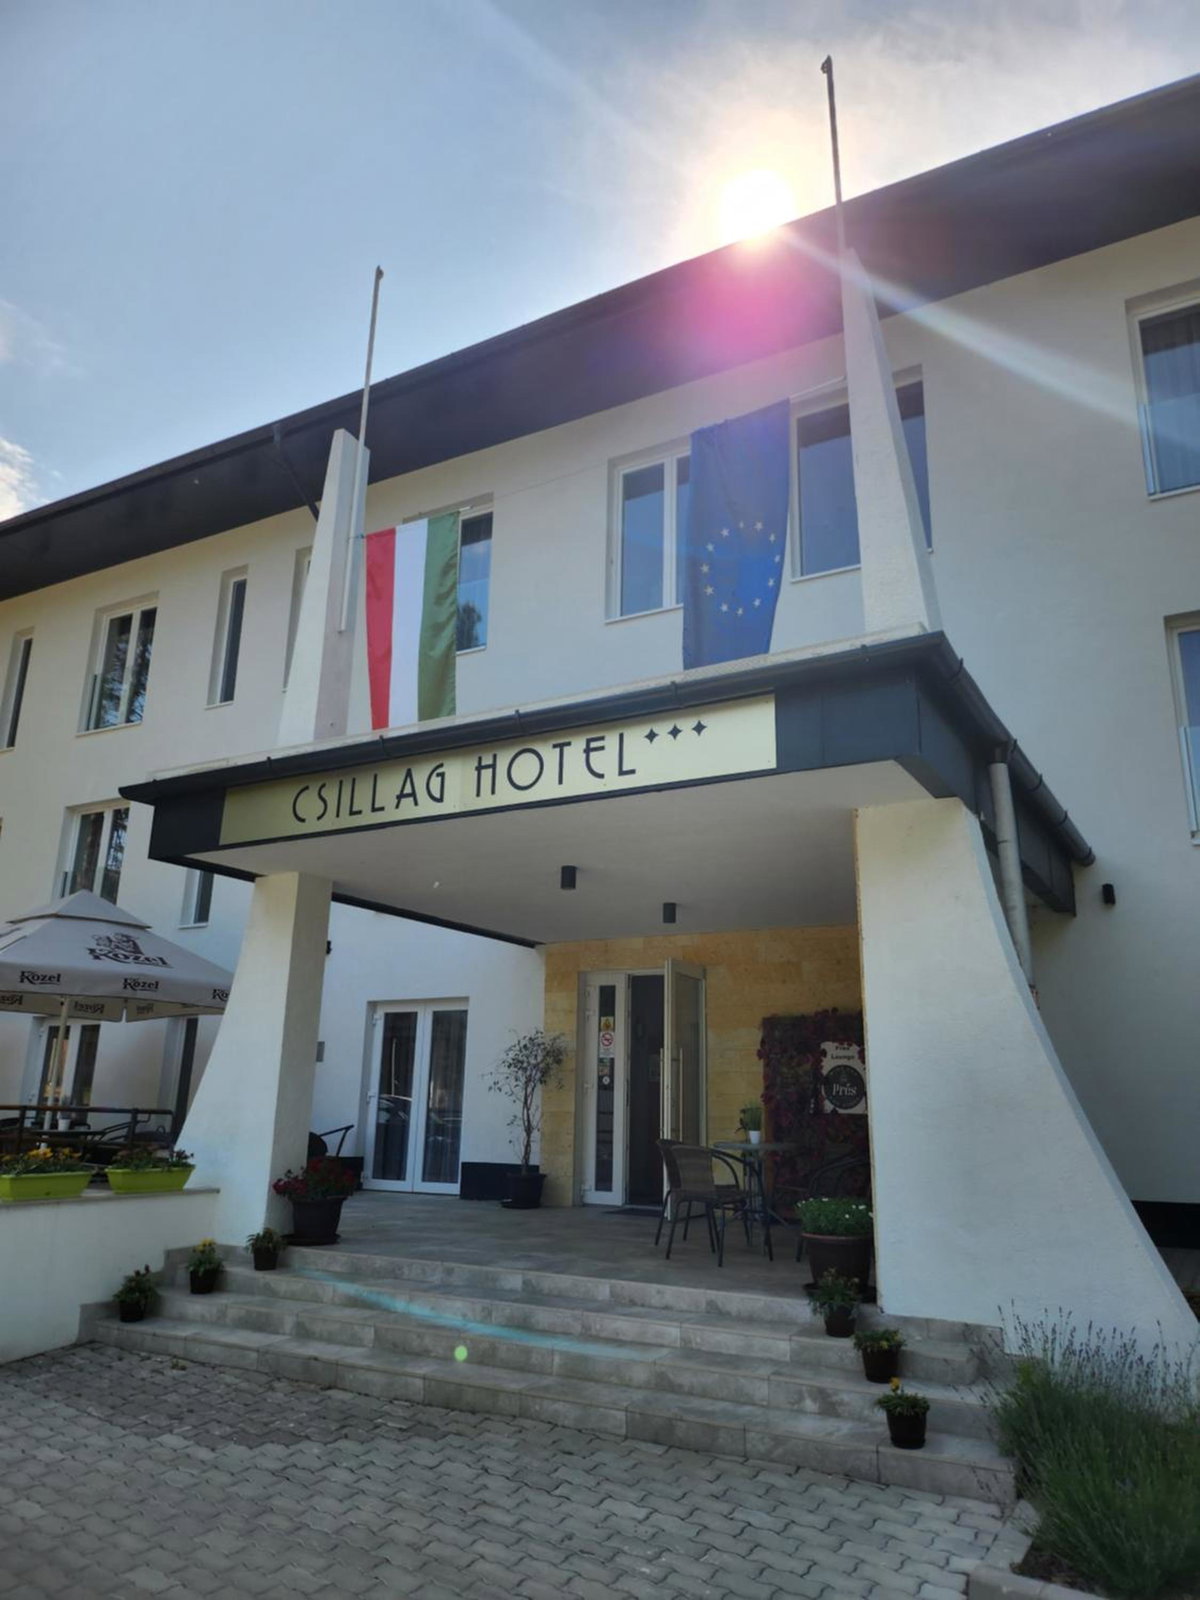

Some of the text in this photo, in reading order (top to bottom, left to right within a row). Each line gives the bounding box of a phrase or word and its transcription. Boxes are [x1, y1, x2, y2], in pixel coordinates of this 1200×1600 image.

[292, 732, 636, 823] CSILLAG HOTEL
[86, 947, 173, 968] Kozel
[20, 970, 62, 985] Kozel
[123, 978, 159, 992] Kozel
